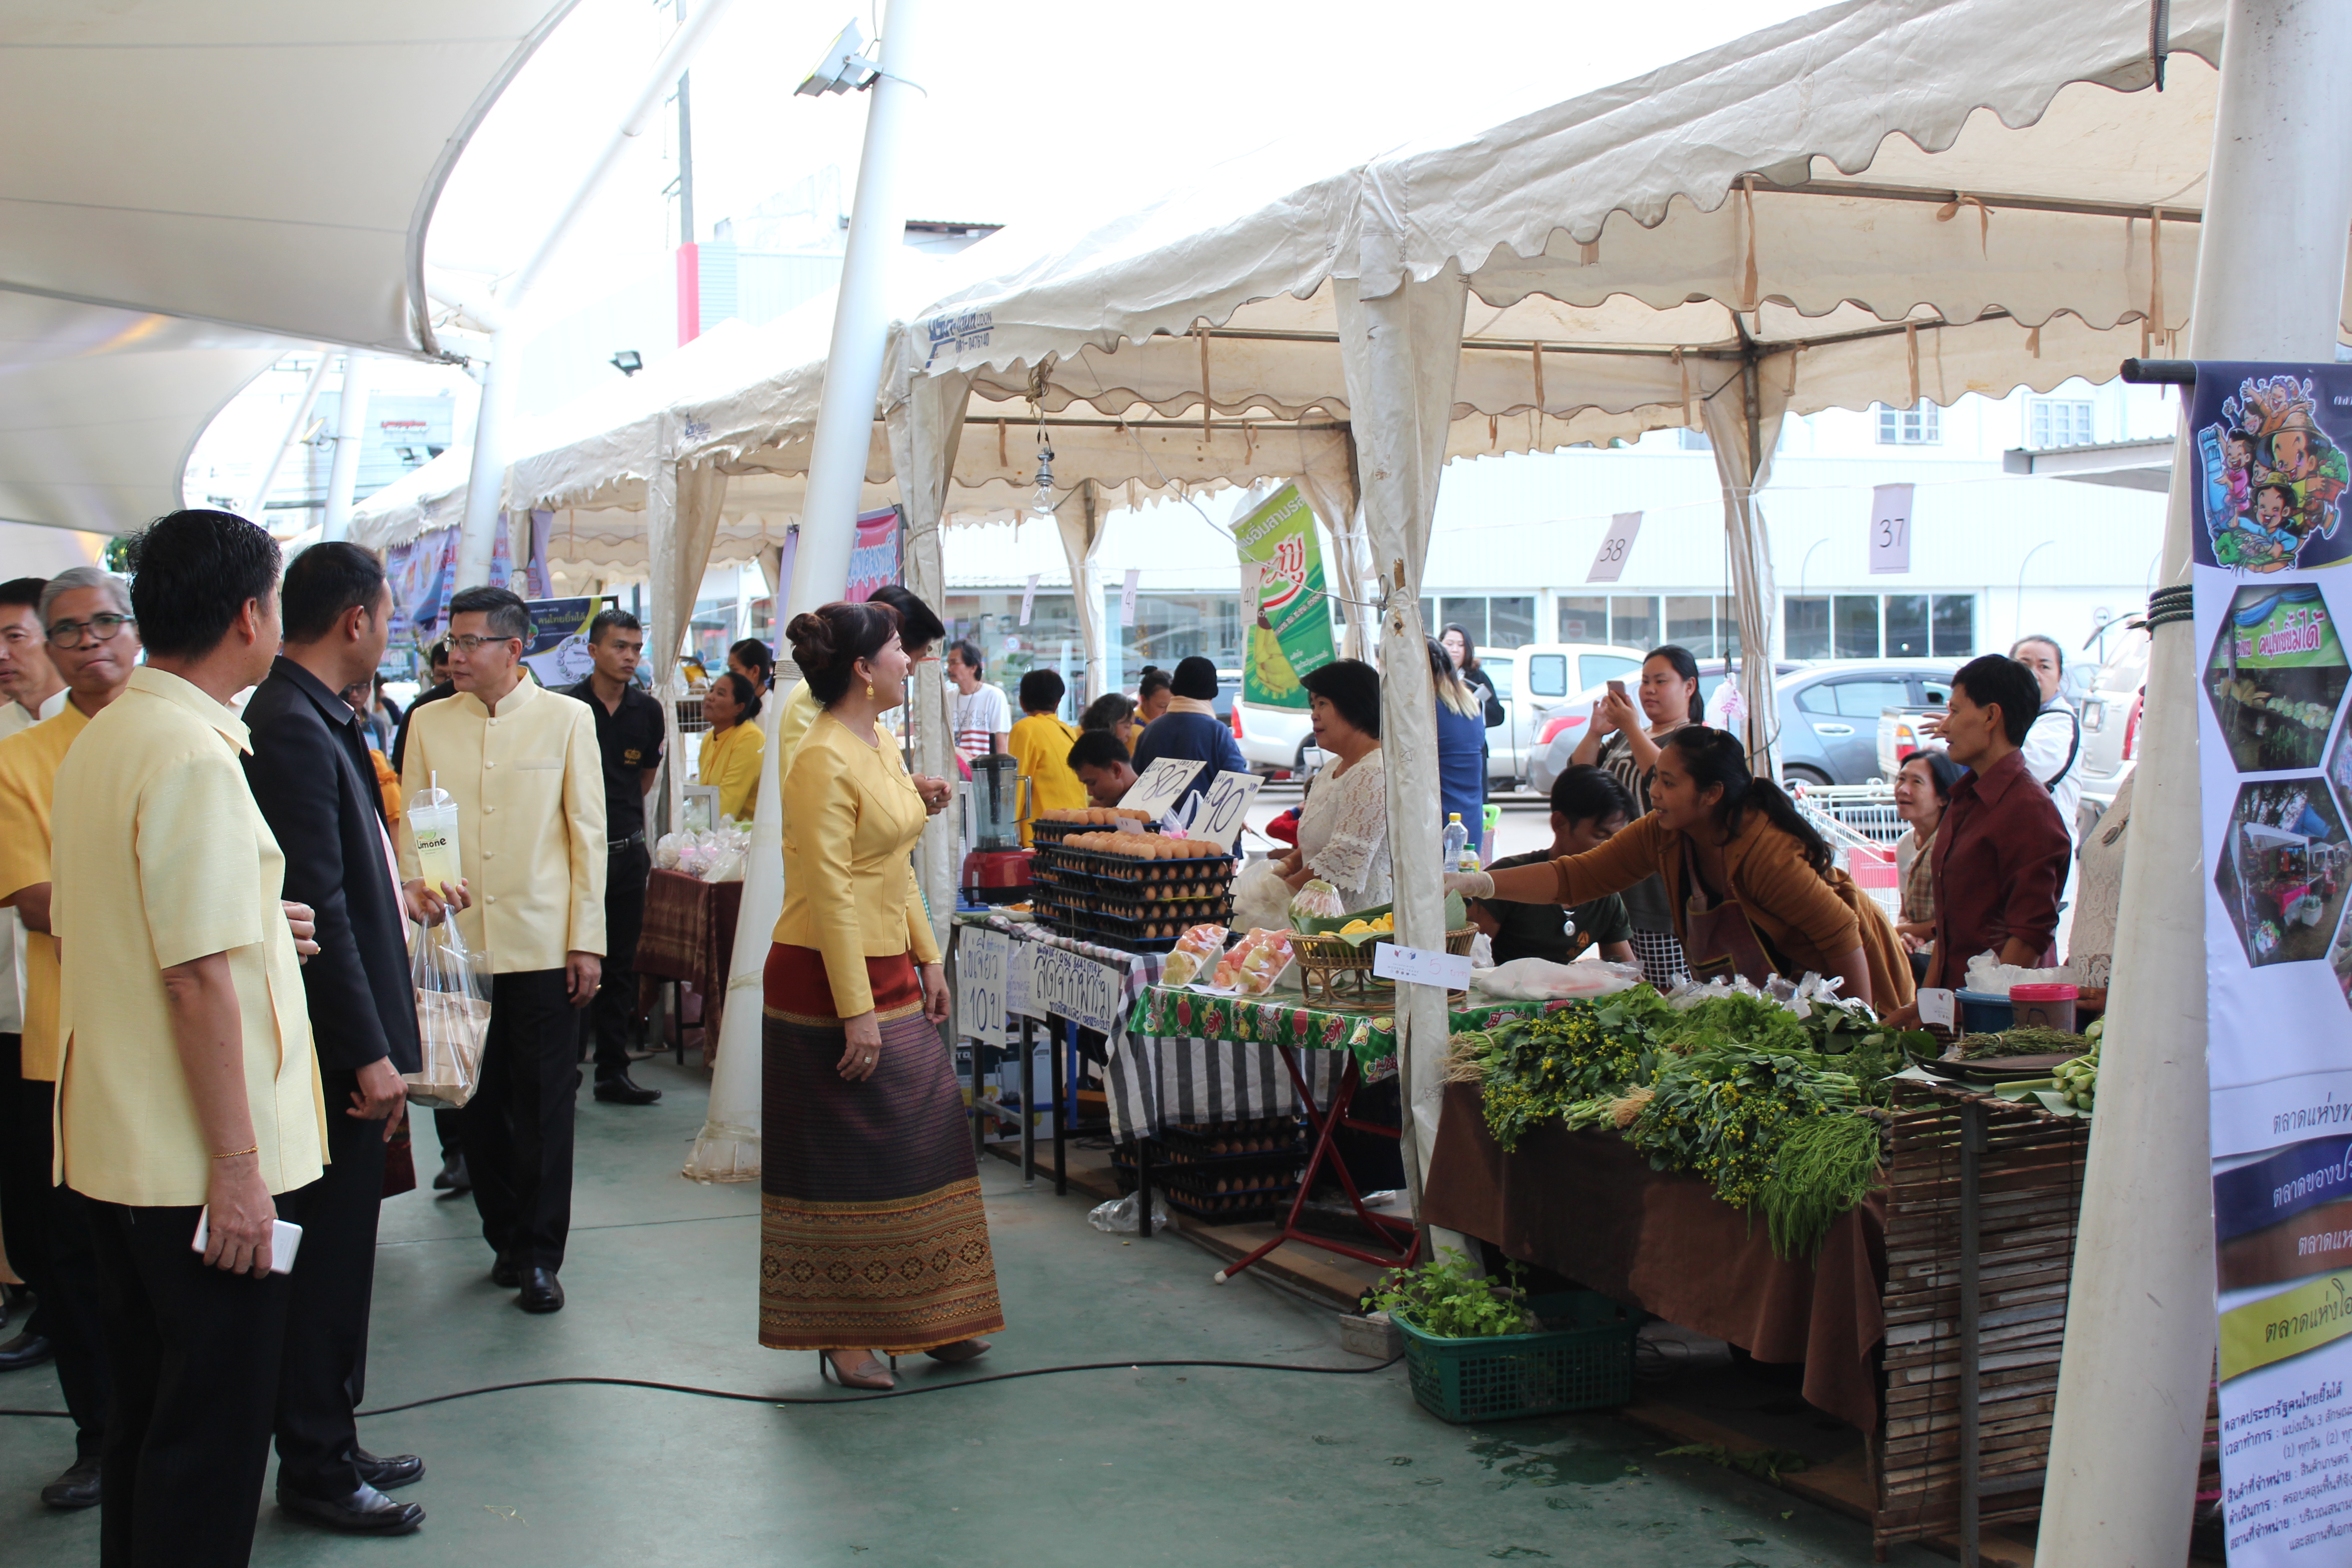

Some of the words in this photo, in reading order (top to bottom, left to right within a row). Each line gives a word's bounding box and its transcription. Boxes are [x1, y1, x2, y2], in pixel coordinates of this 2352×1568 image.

[976, 311, 992, 326] UDON
[1879, 518, 1905, 547] 37
[1600, 539, 1626, 562] 38
[1244, 587, 1255, 607] 40
[1141, 764, 1188, 801] 80
[1203, 777, 1245, 833] 90
[416, 838, 447, 849] Limone
[962, 930, 998, 980] ไข่เจียว
[1429, 958, 1441, 975] 5
[2224, 1381, 2342, 1433] ตลาดประชารัฐคนไทยยิ้มได้
[2317, 1414, 2322, 1426] 3
[2283, 1442, 2295, 1460] (1)
[2297, 1436, 2320, 1457] ทุกวัน
[2326, 1429, 2338, 1446] (2)
